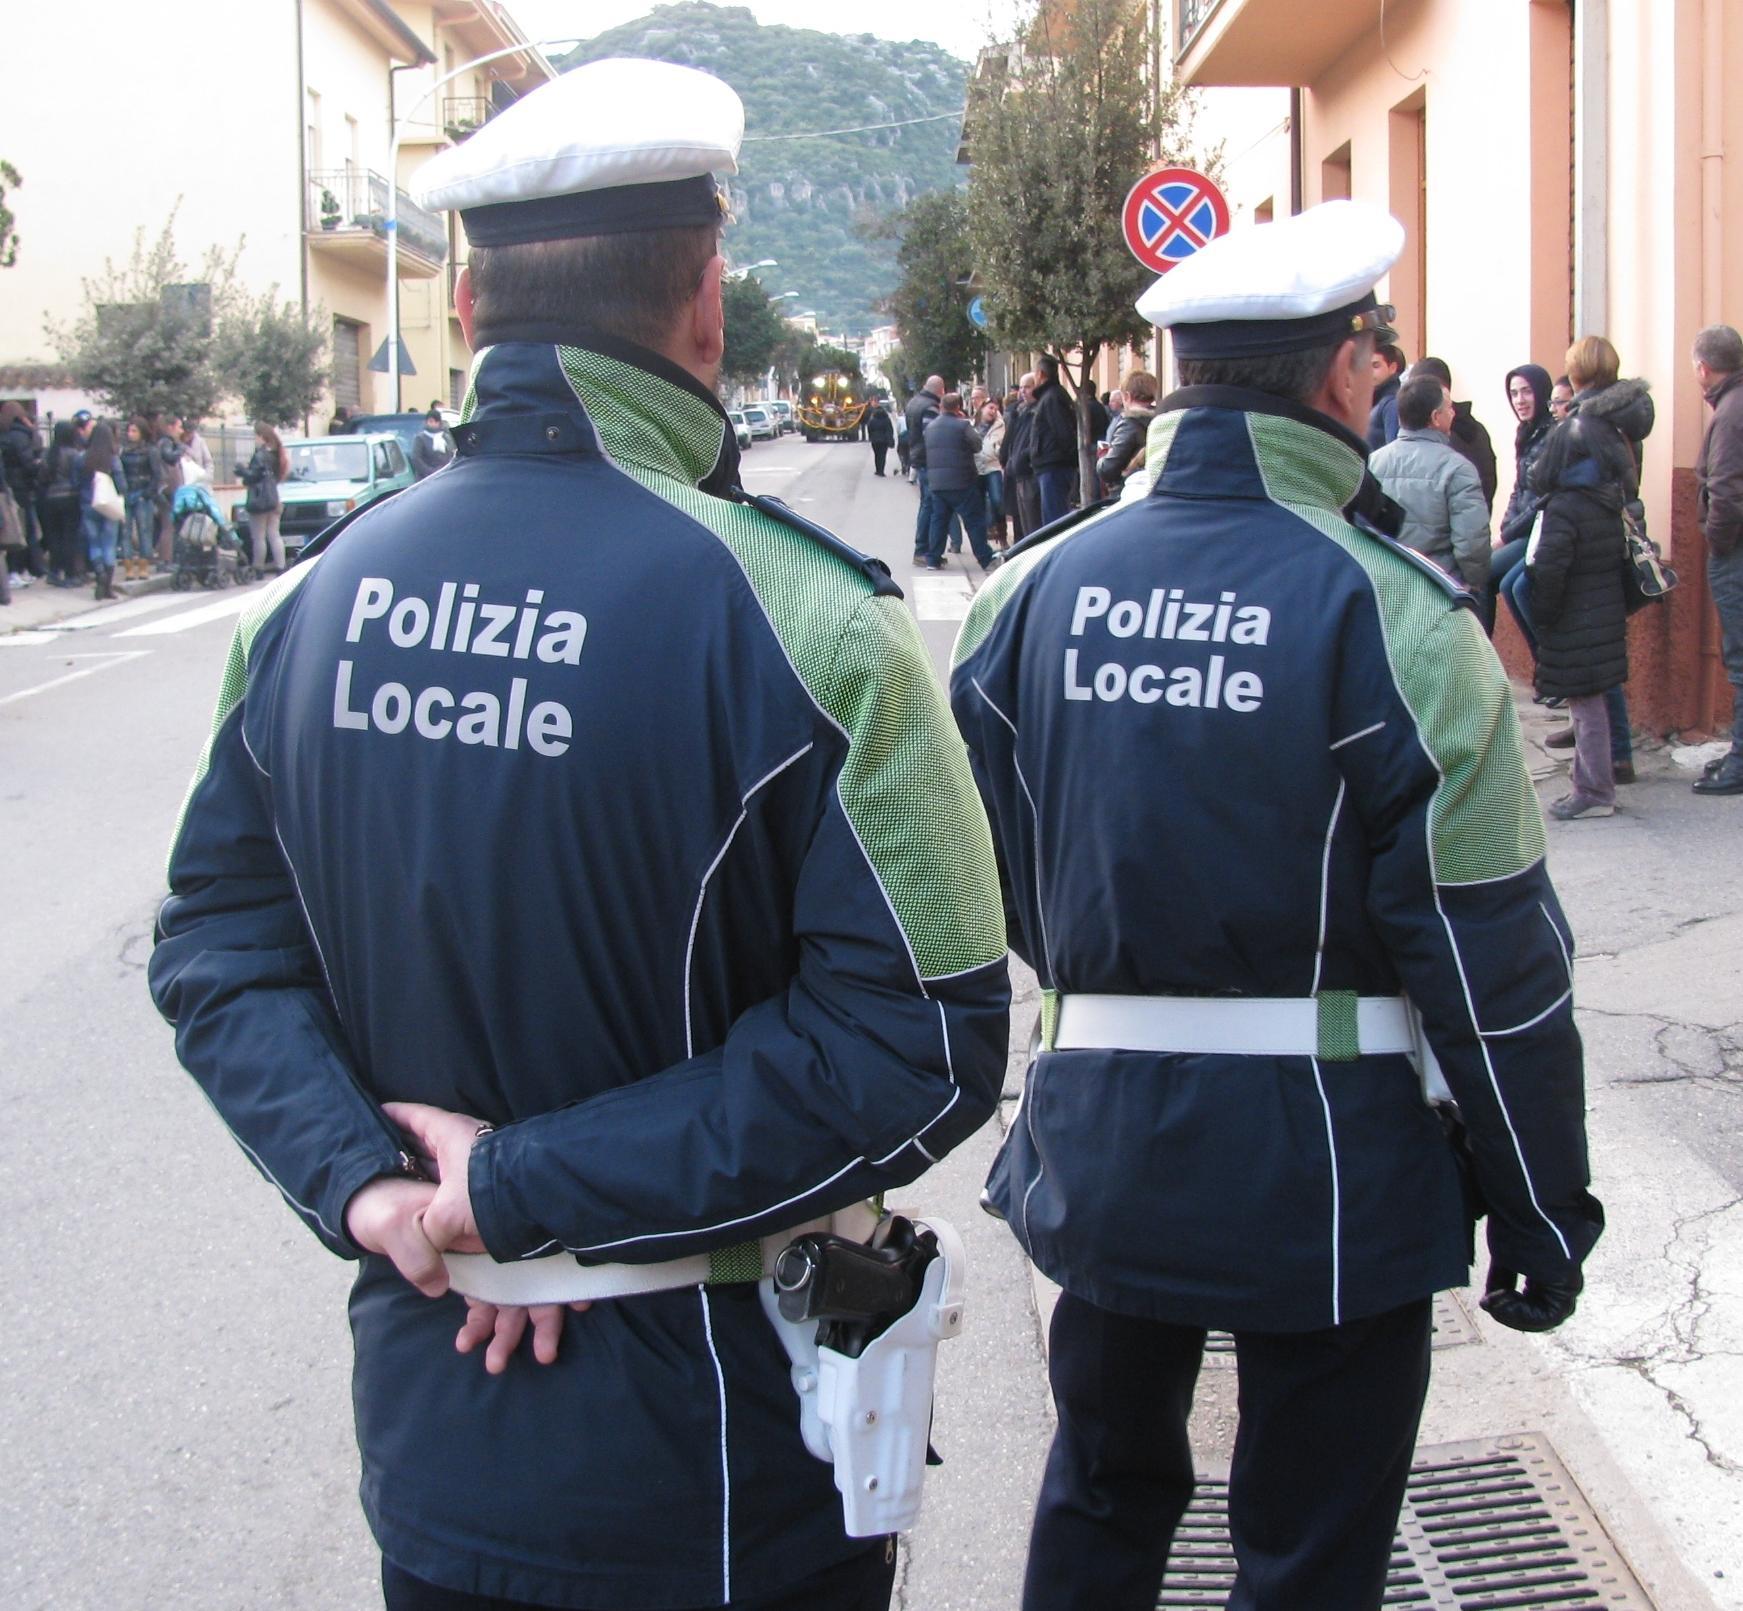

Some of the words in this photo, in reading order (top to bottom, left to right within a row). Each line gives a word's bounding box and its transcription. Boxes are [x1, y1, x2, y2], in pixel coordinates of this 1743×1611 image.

[345, 577, 588, 666] Polizia
[1070, 586, 1271, 646] Polizia
[333, 659, 573, 757] Locale
[1064, 648, 1264, 713] Locale
